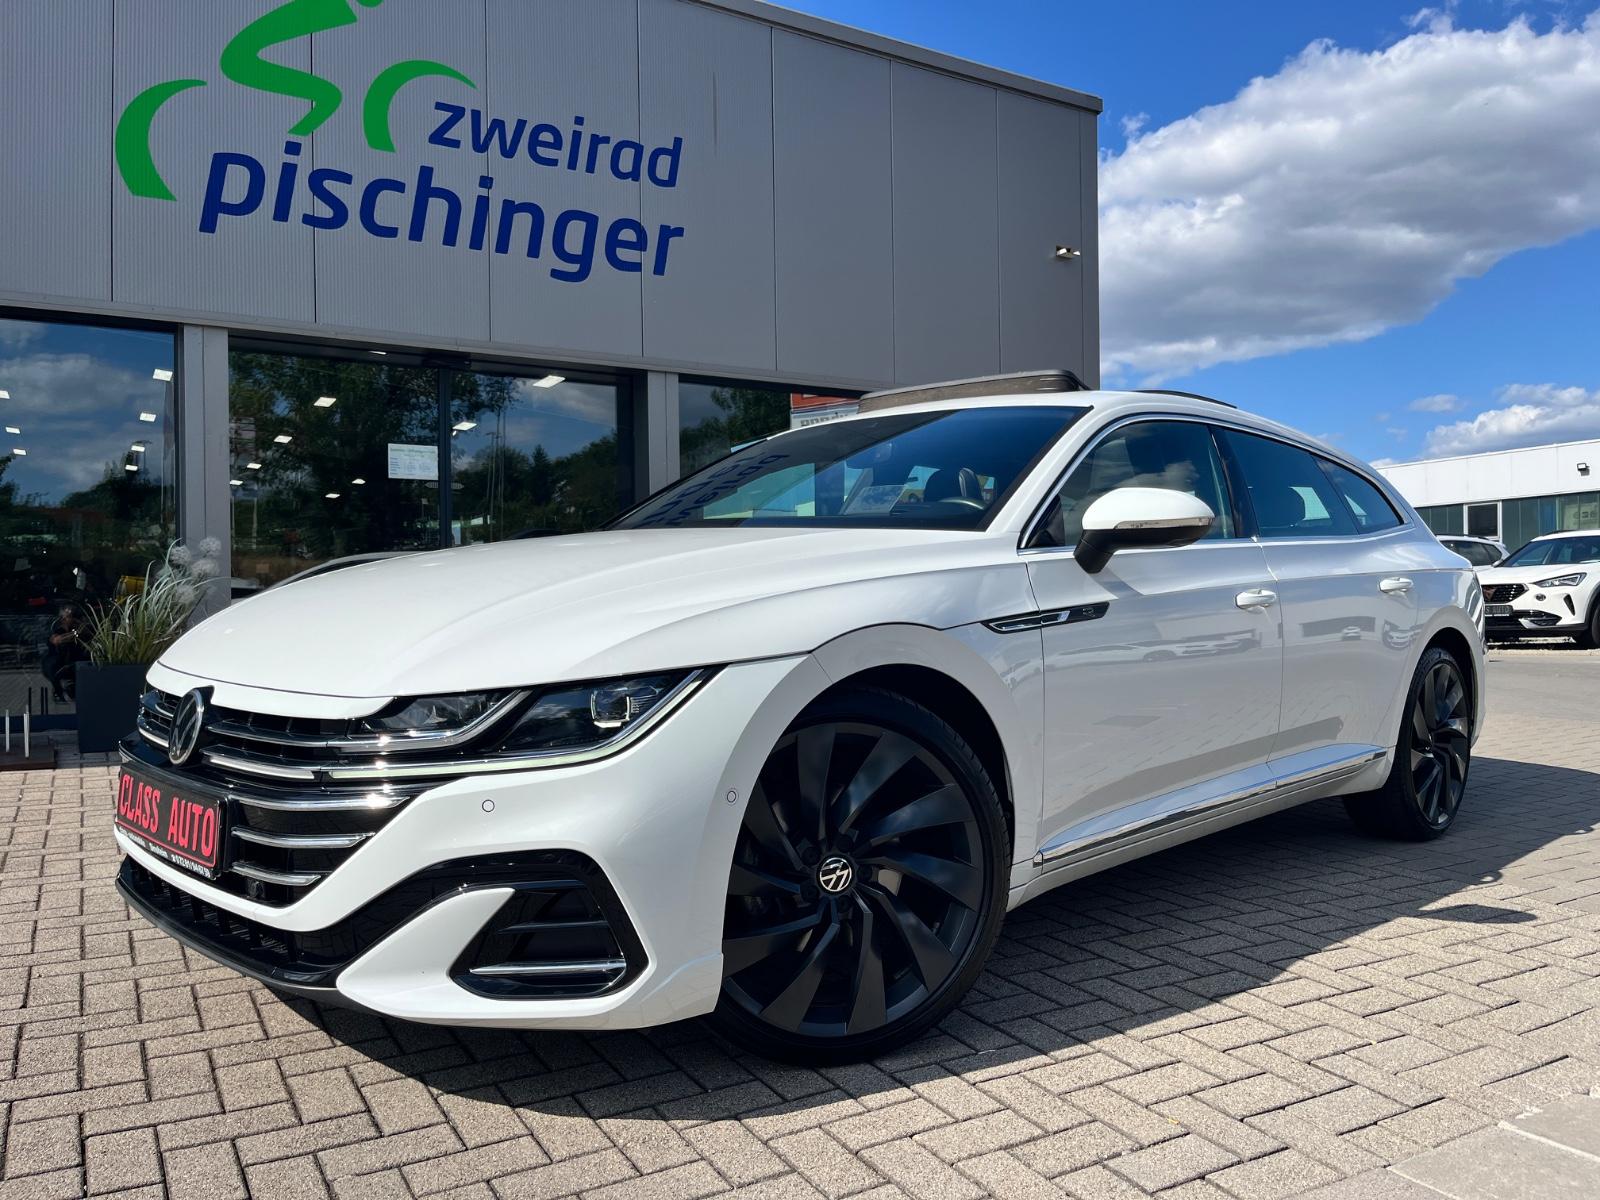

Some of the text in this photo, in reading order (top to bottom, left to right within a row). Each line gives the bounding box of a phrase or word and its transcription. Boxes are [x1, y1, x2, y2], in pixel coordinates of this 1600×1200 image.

[428, 101, 683, 188] zweirad
[199, 140, 684, 283] pischinger
[119, 773, 215, 857] CLASS AUTO
